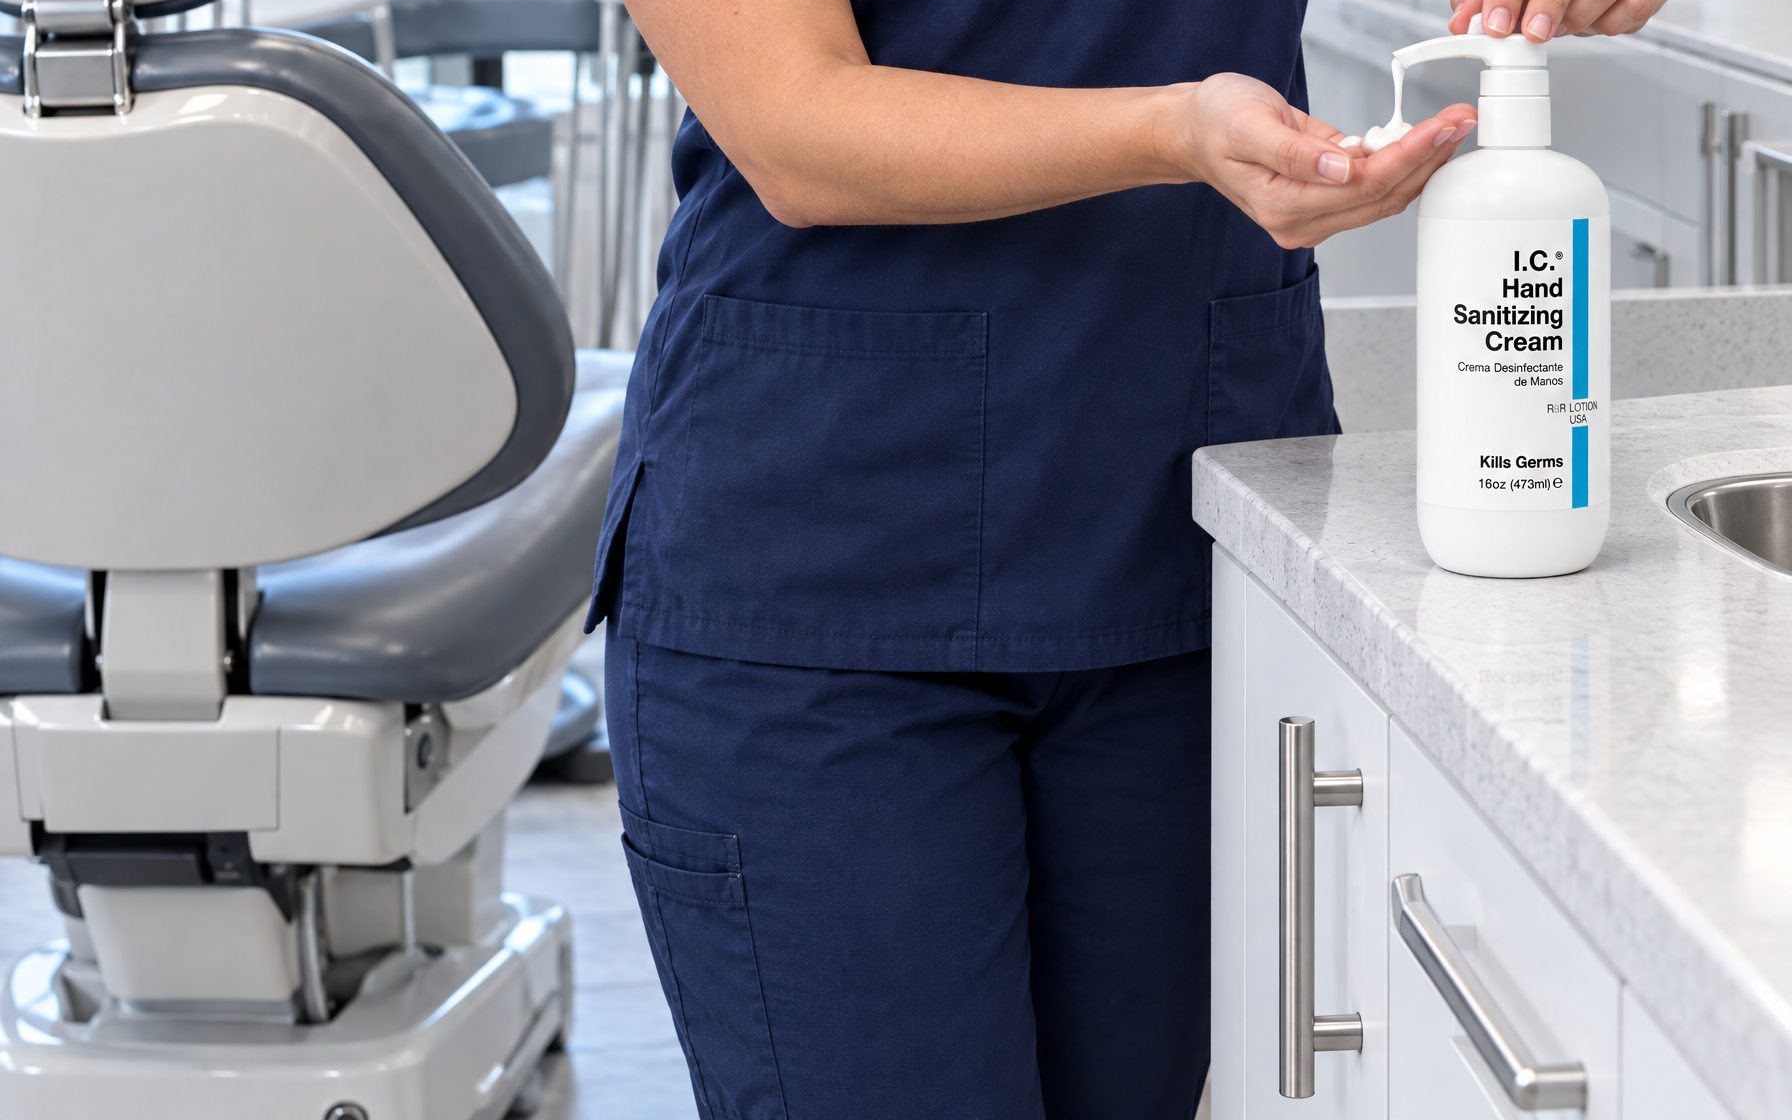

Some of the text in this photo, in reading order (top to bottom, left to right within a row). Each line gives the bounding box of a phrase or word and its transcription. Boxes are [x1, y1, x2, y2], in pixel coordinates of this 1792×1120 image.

[1502, 277, 1563, 298] Hand
[1453, 303, 1564, 330] Sanitizing
[1484, 330, 1563, 352] Cream
[1457, 361, 1564, 373] Crema Desinfectante
[1513, 376, 1564, 387] de Manos
[1569, 400, 1598, 413] LOTION
[1569, 414, 1588, 425] USA
[1479, 455, 1564, 469] Kills Germs
[1478, 478, 1507, 490] 16oz
[1509, 477, 1551, 492] (473ml)
